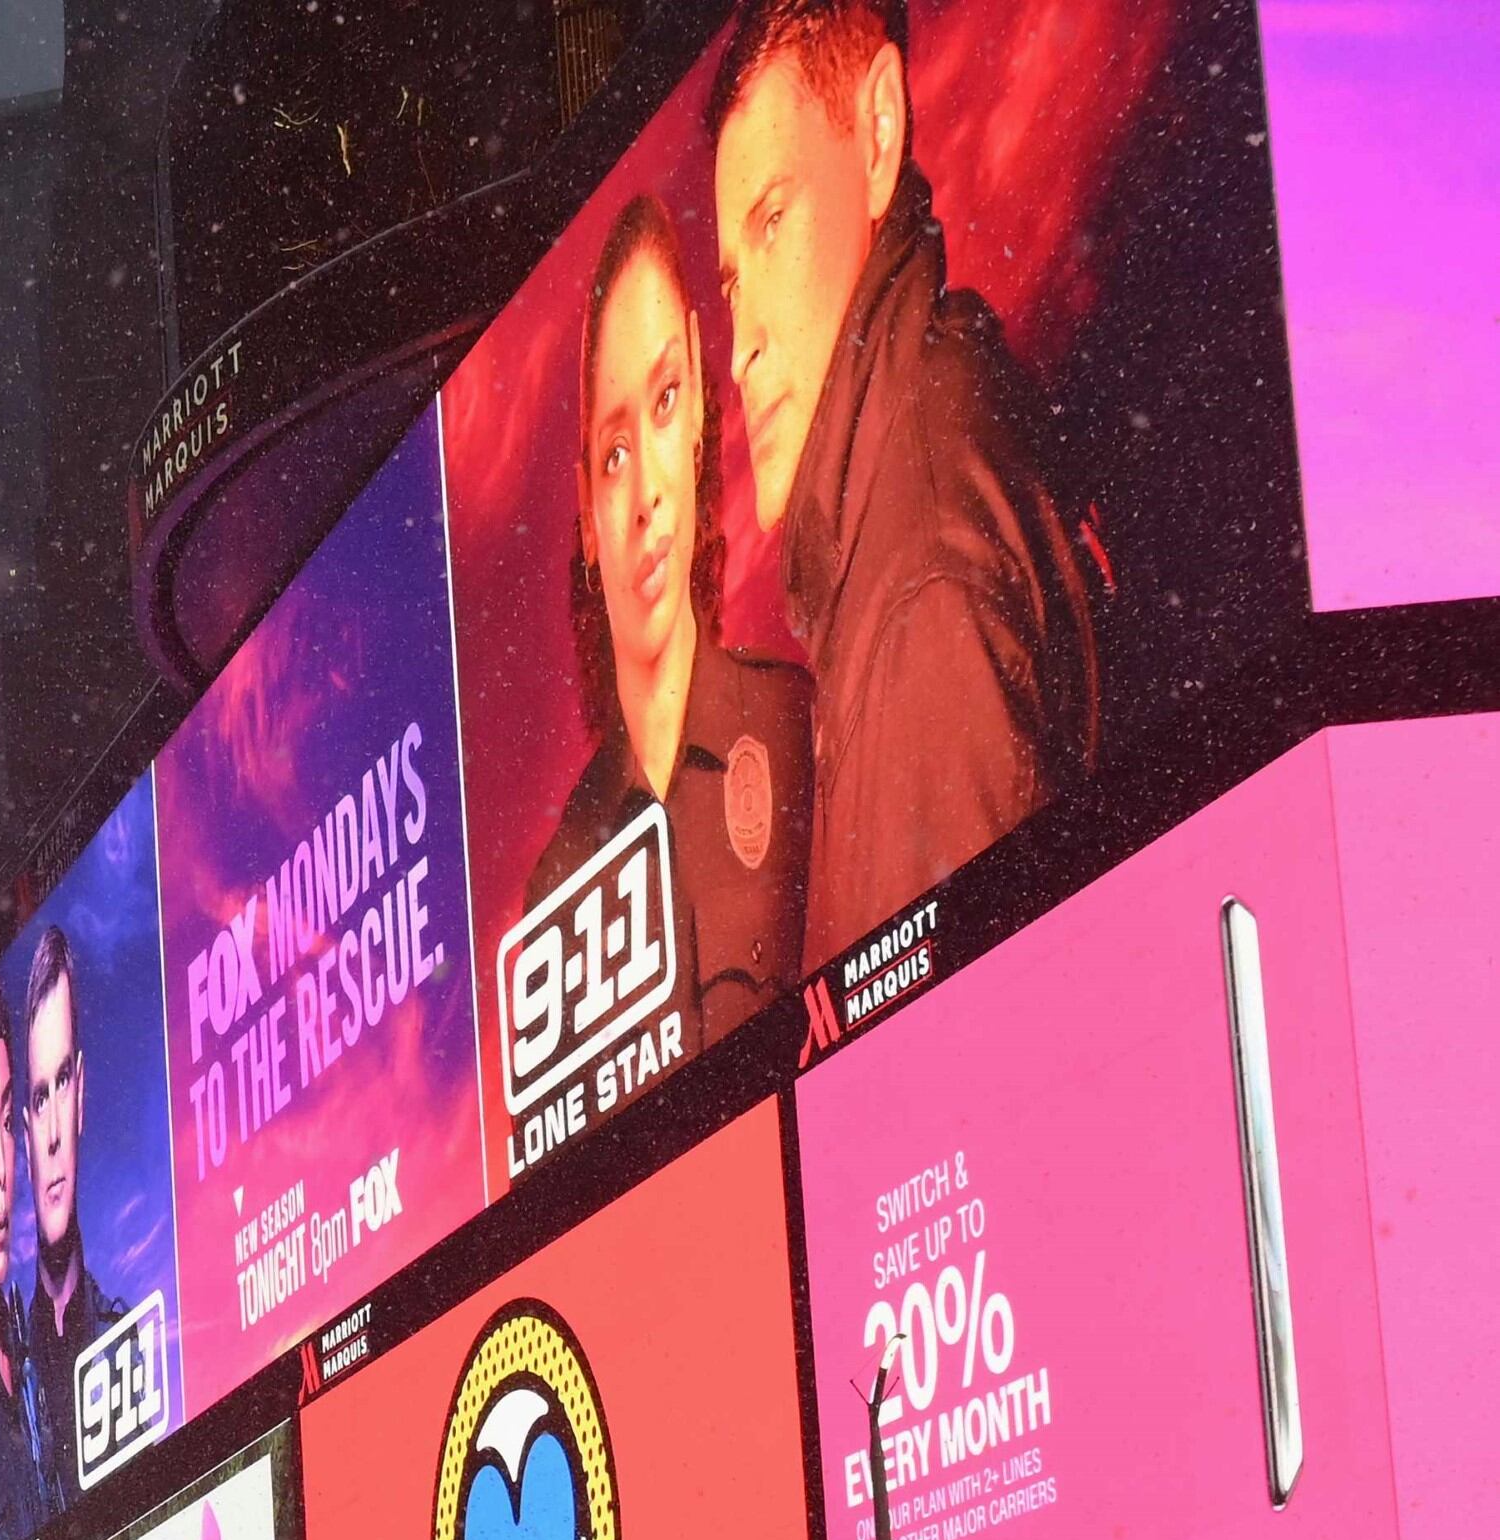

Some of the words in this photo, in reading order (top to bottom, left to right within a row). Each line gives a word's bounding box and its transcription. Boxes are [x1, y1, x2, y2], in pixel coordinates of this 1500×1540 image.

[142, 340, 243, 475] MARRIOTT
[145, 400, 230, 519] MARQUIS
[187, 895, 262, 1063] FOX
[265, 722, 427, 985] MONDAYS
[844, 901, 939, 988] MARRIOTT
[846, 948, 932, 1026] MARQUIS
[190, 1065, 229, 1182] TO
[231, 998, 291, 1143] THE
[300, 856, 444, 1088] RESCUE.
[508, 1092, 588, 1182] LONE
[597, 1009, 685, 1114] STAR
[234, 1213, 264, 1264] NEW
[262, 1180, 305, 1241] SEASON
[876, 1160, 951, 1234] SWITCH
[955, 1150, 969, 1190] &
[236, 1222, 308, 1332] TONIGHT
[310, 1203, 348, 1283] 8pm
[348, 1148, 404, 1244] FOX
[872, 1240, 920, 1291] SAVE
[924, 1214, 952, 1263] UP
[957, 1197, 985, 1241] TO
[321, 1304, 372, 1355] MARRIOTT
[322, 1334, 369, 1382] MARQUIS
[863, 1249, 1014, 1426] 20%
[844, 1419, 932, 1508] EVERY
[939, 1368, 1051, 1468] MONTH
[913, 1487, 946, 1522] PLAN
[950, 1475, 981, 1509] WITH
[984, 1467, 1000, 1493] 2+
[1002, 1448, 1042, 1485] LINES
[989, 1477, 1057, 1527] CARRIERS
